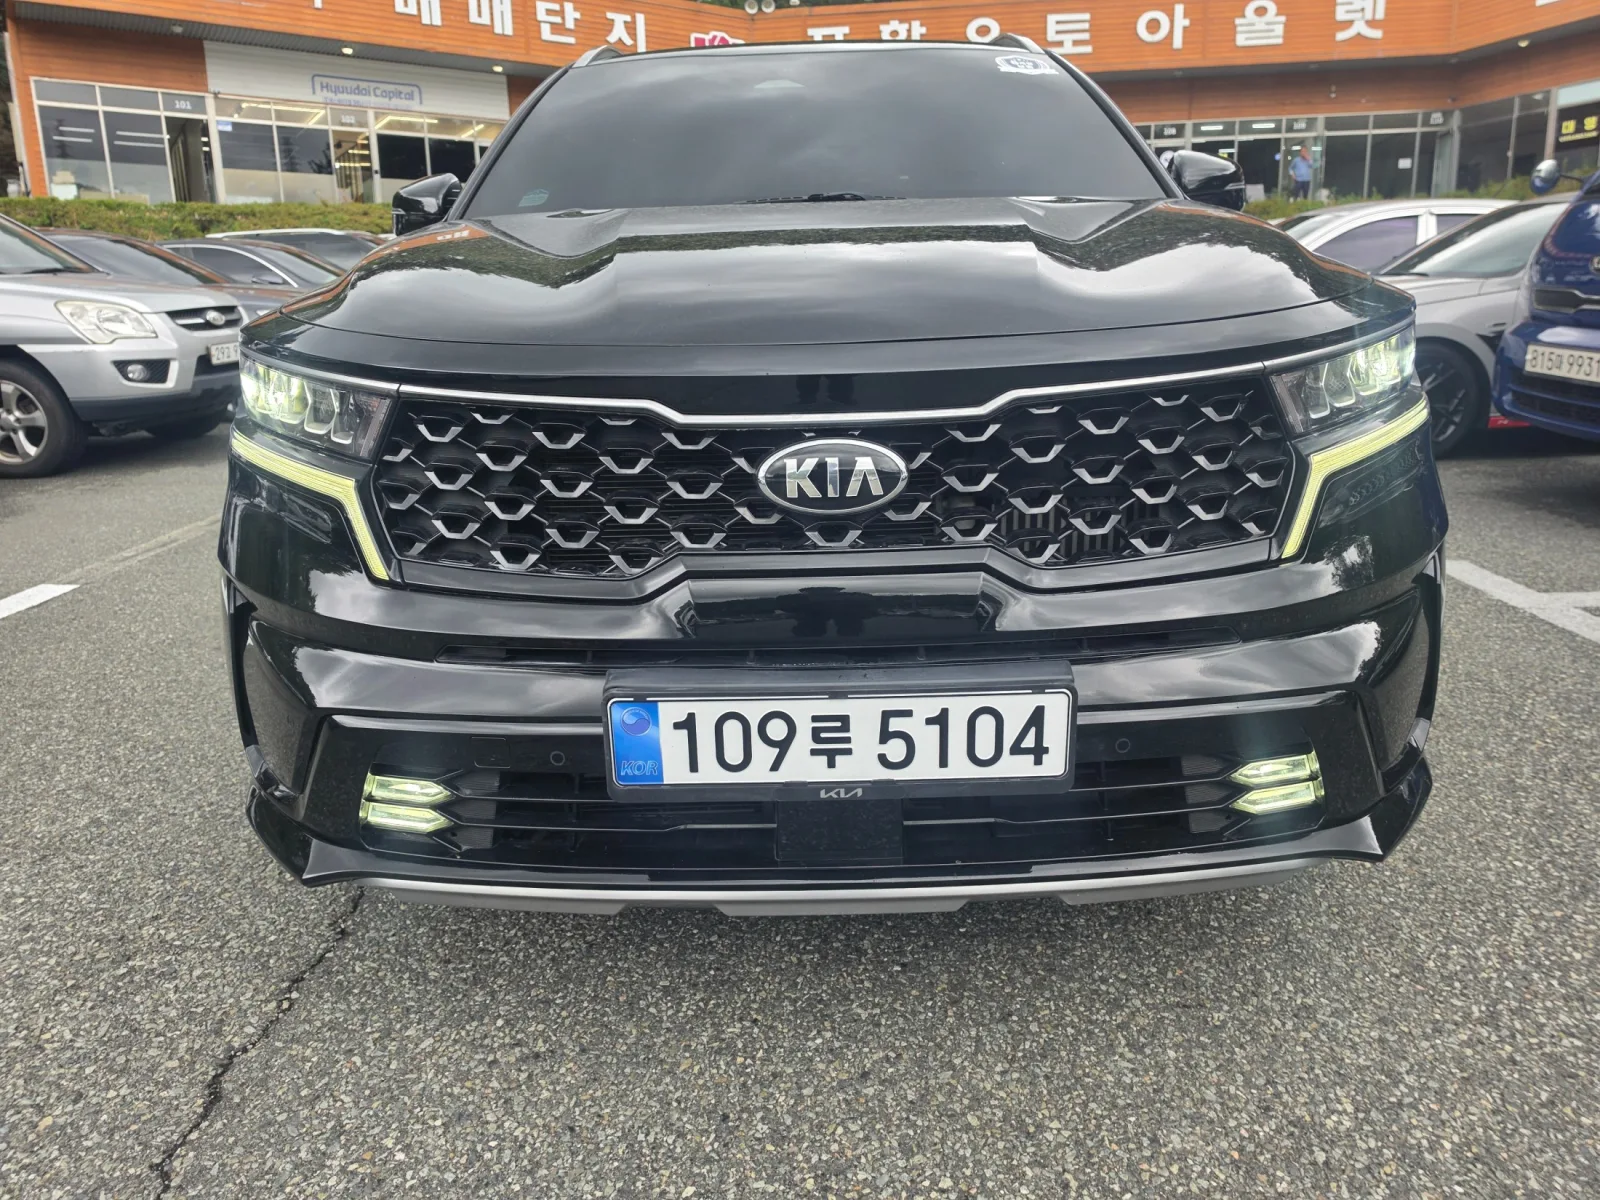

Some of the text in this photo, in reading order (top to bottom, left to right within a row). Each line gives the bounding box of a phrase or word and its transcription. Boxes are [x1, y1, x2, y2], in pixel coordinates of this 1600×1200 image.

[373, 86, 414, 101] Capital
[784, 457, 884, 498] KIA
[672, 704, 1050, 773] 109루 5104
[620, 760, 659, 776] KOR
[820, 787, 863, 799] KIA
